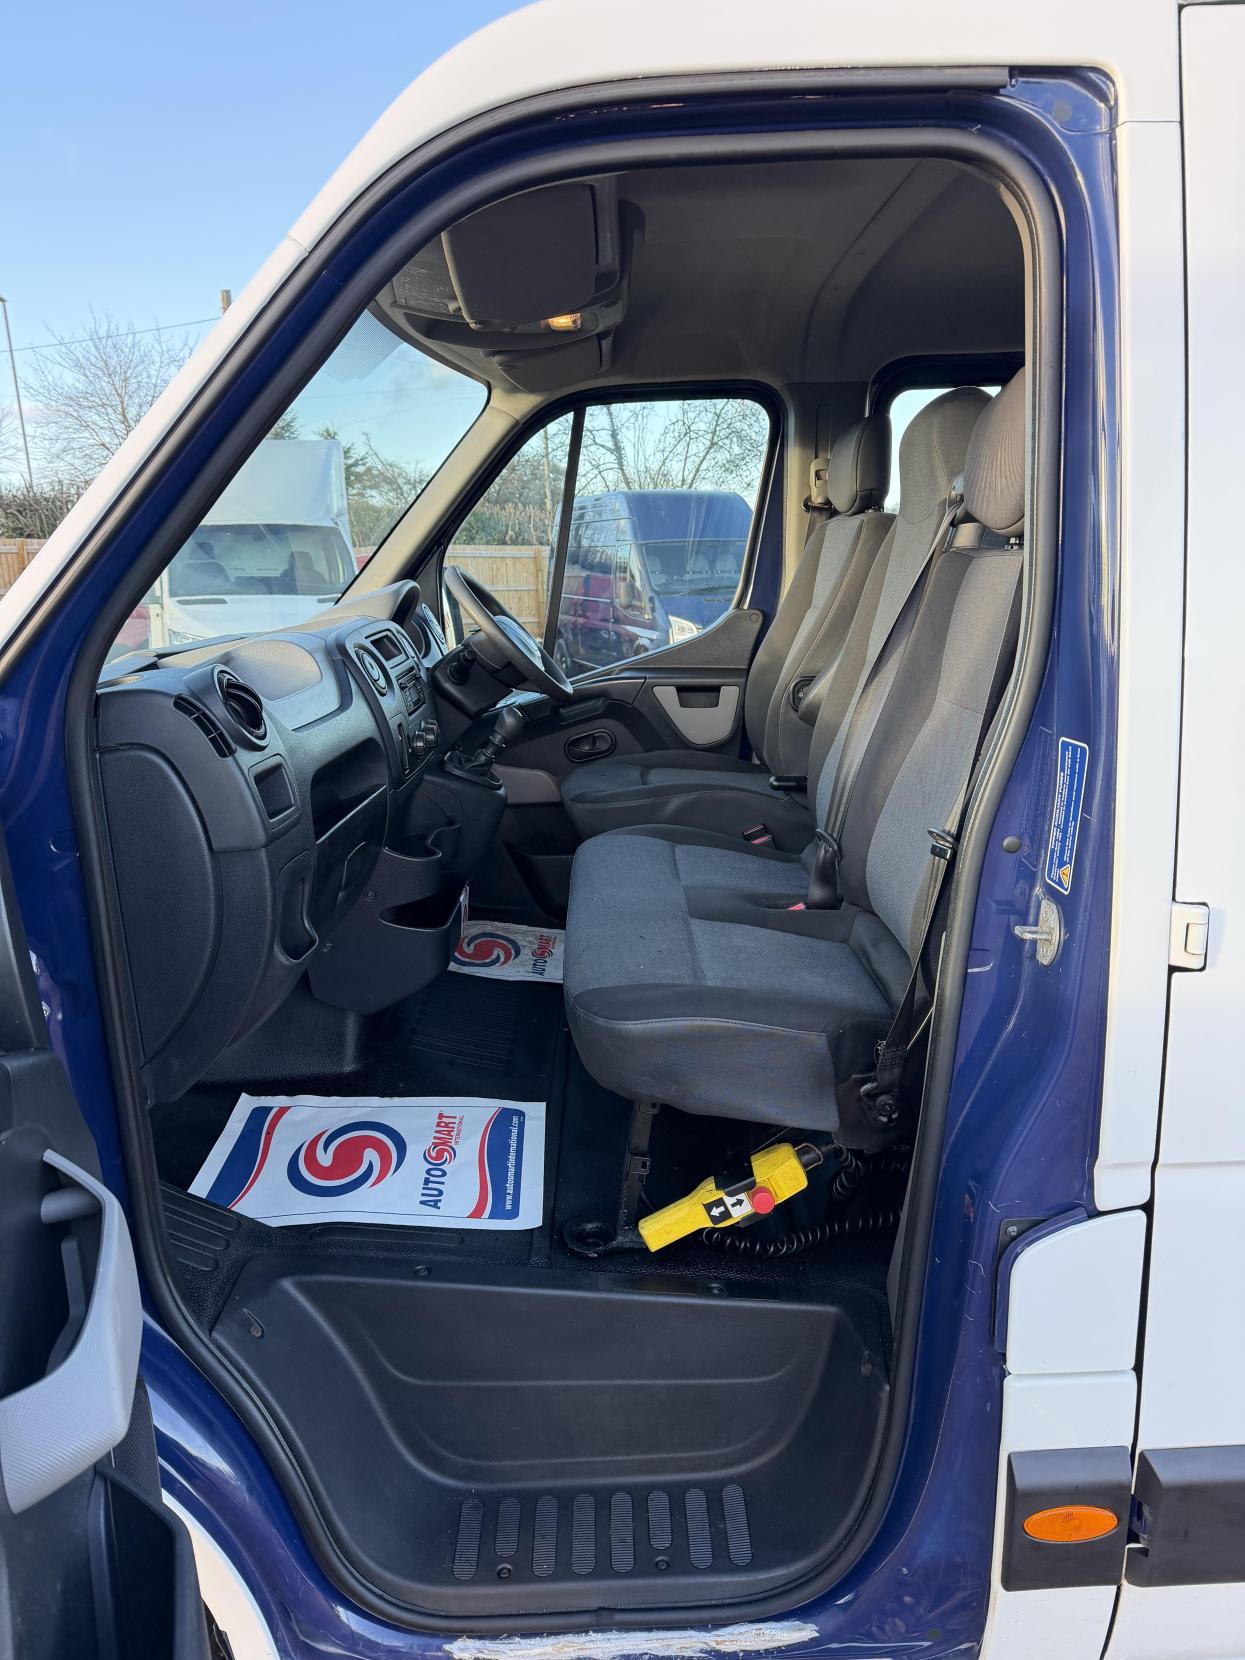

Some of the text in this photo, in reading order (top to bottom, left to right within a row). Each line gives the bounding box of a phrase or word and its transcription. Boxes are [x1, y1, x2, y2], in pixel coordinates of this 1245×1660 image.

[419, 1111, 457, 1210] AUTOSMART
[453, 1115, 465, 1145] INTERNATIONAL
[504, 1115, 519, 1210] www.autosmartinternational.com
